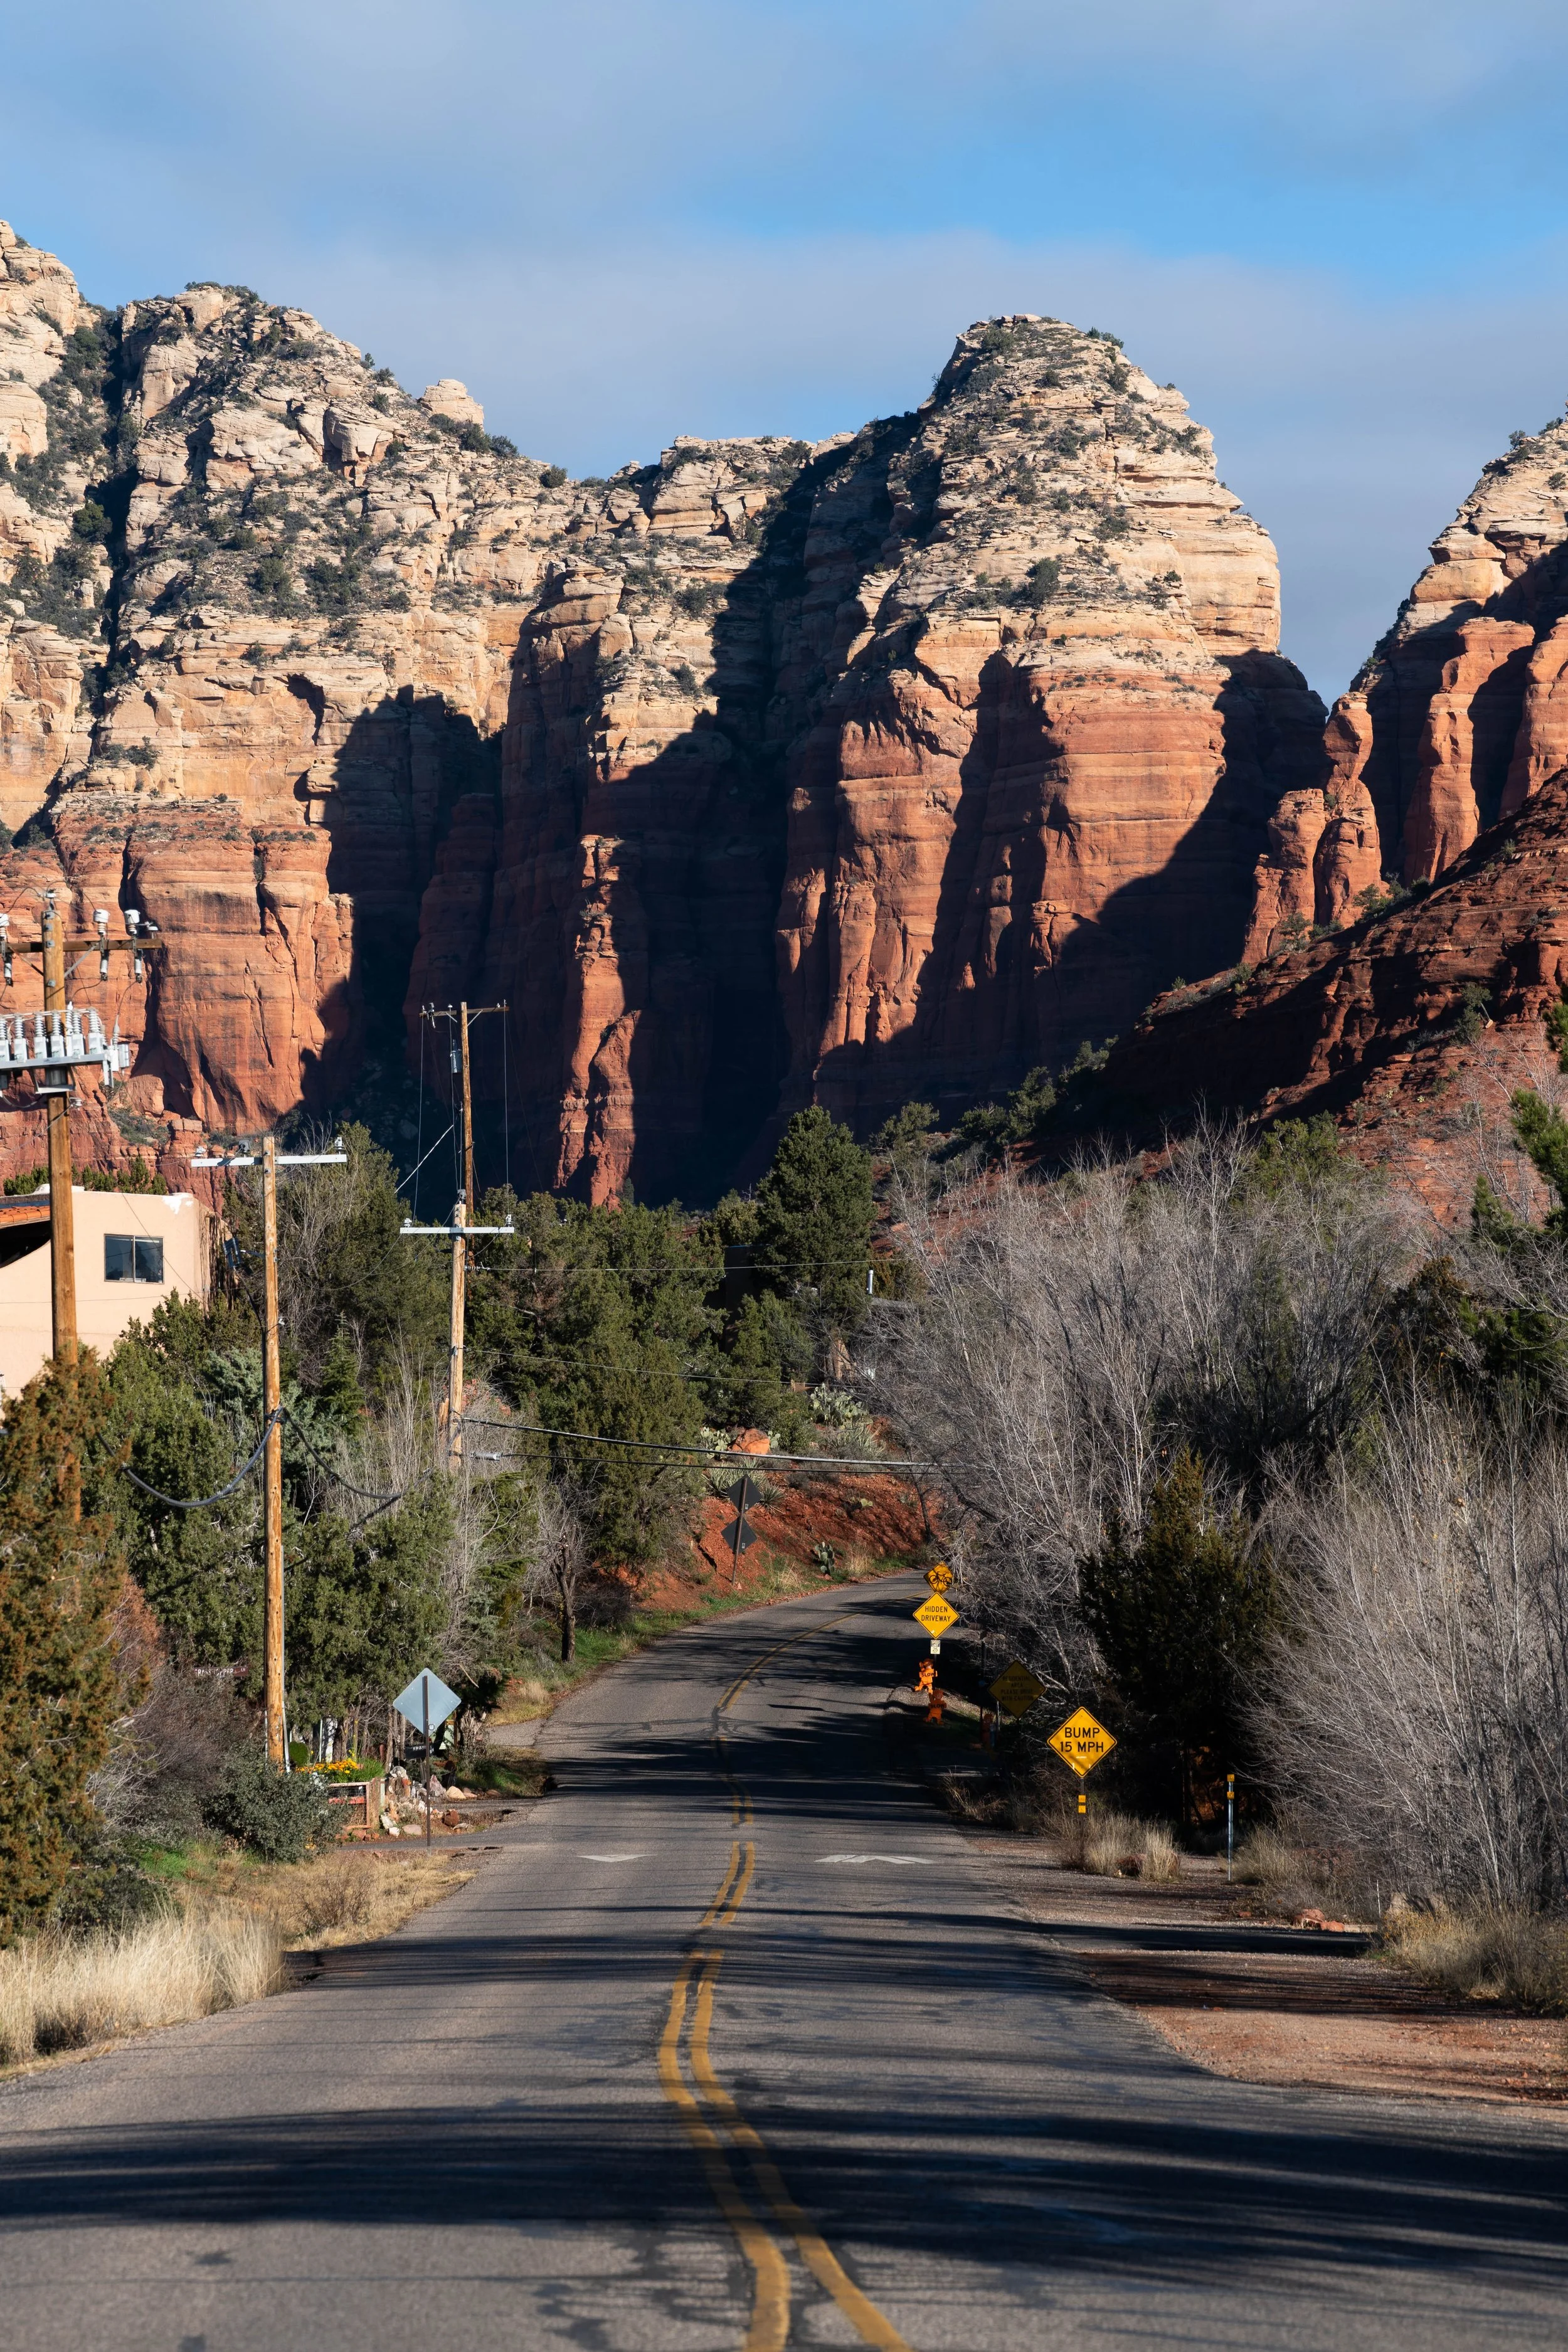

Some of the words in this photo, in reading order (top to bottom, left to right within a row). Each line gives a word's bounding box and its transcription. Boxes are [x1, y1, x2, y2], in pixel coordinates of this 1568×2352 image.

[1064, 1727, 1100, 1738] BUMP
[1060, 1741, 1072, 1752] 15
[1078, 1741, 1104, 1752] MPH
